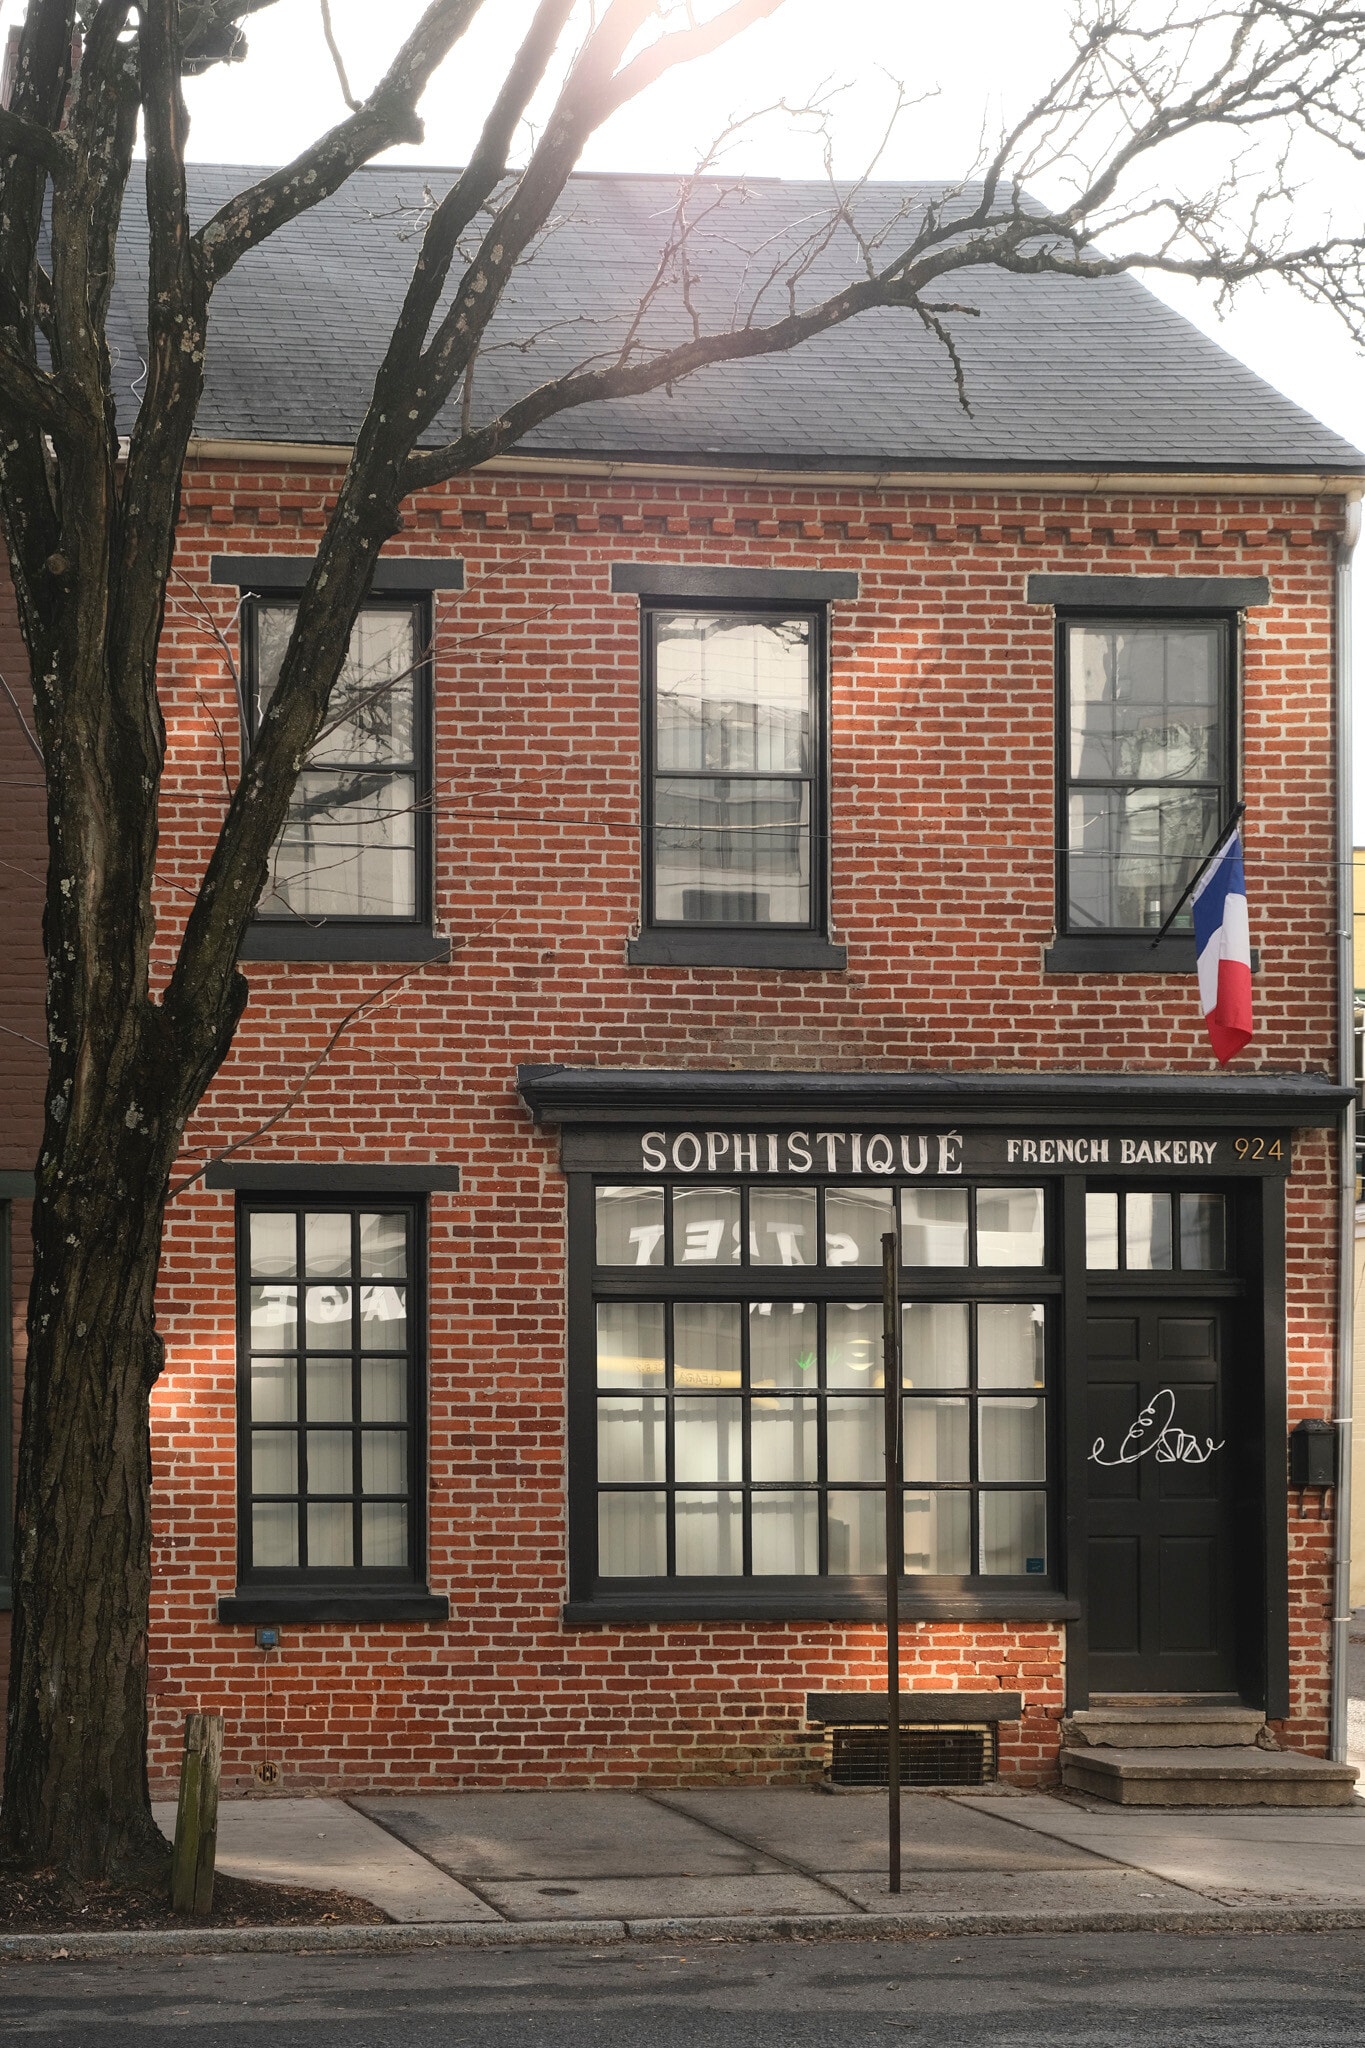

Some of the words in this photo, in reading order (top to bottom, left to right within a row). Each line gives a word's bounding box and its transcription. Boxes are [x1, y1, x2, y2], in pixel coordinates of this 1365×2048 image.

[641, 1129, 963, 1174] SOPHISTIQUÉ
[1007, 1138, 1109, 1163] FRENCH
[1120, 1139, 1218, 1164] BAKERY
[1235, 1137, 1284, 1161] 924
